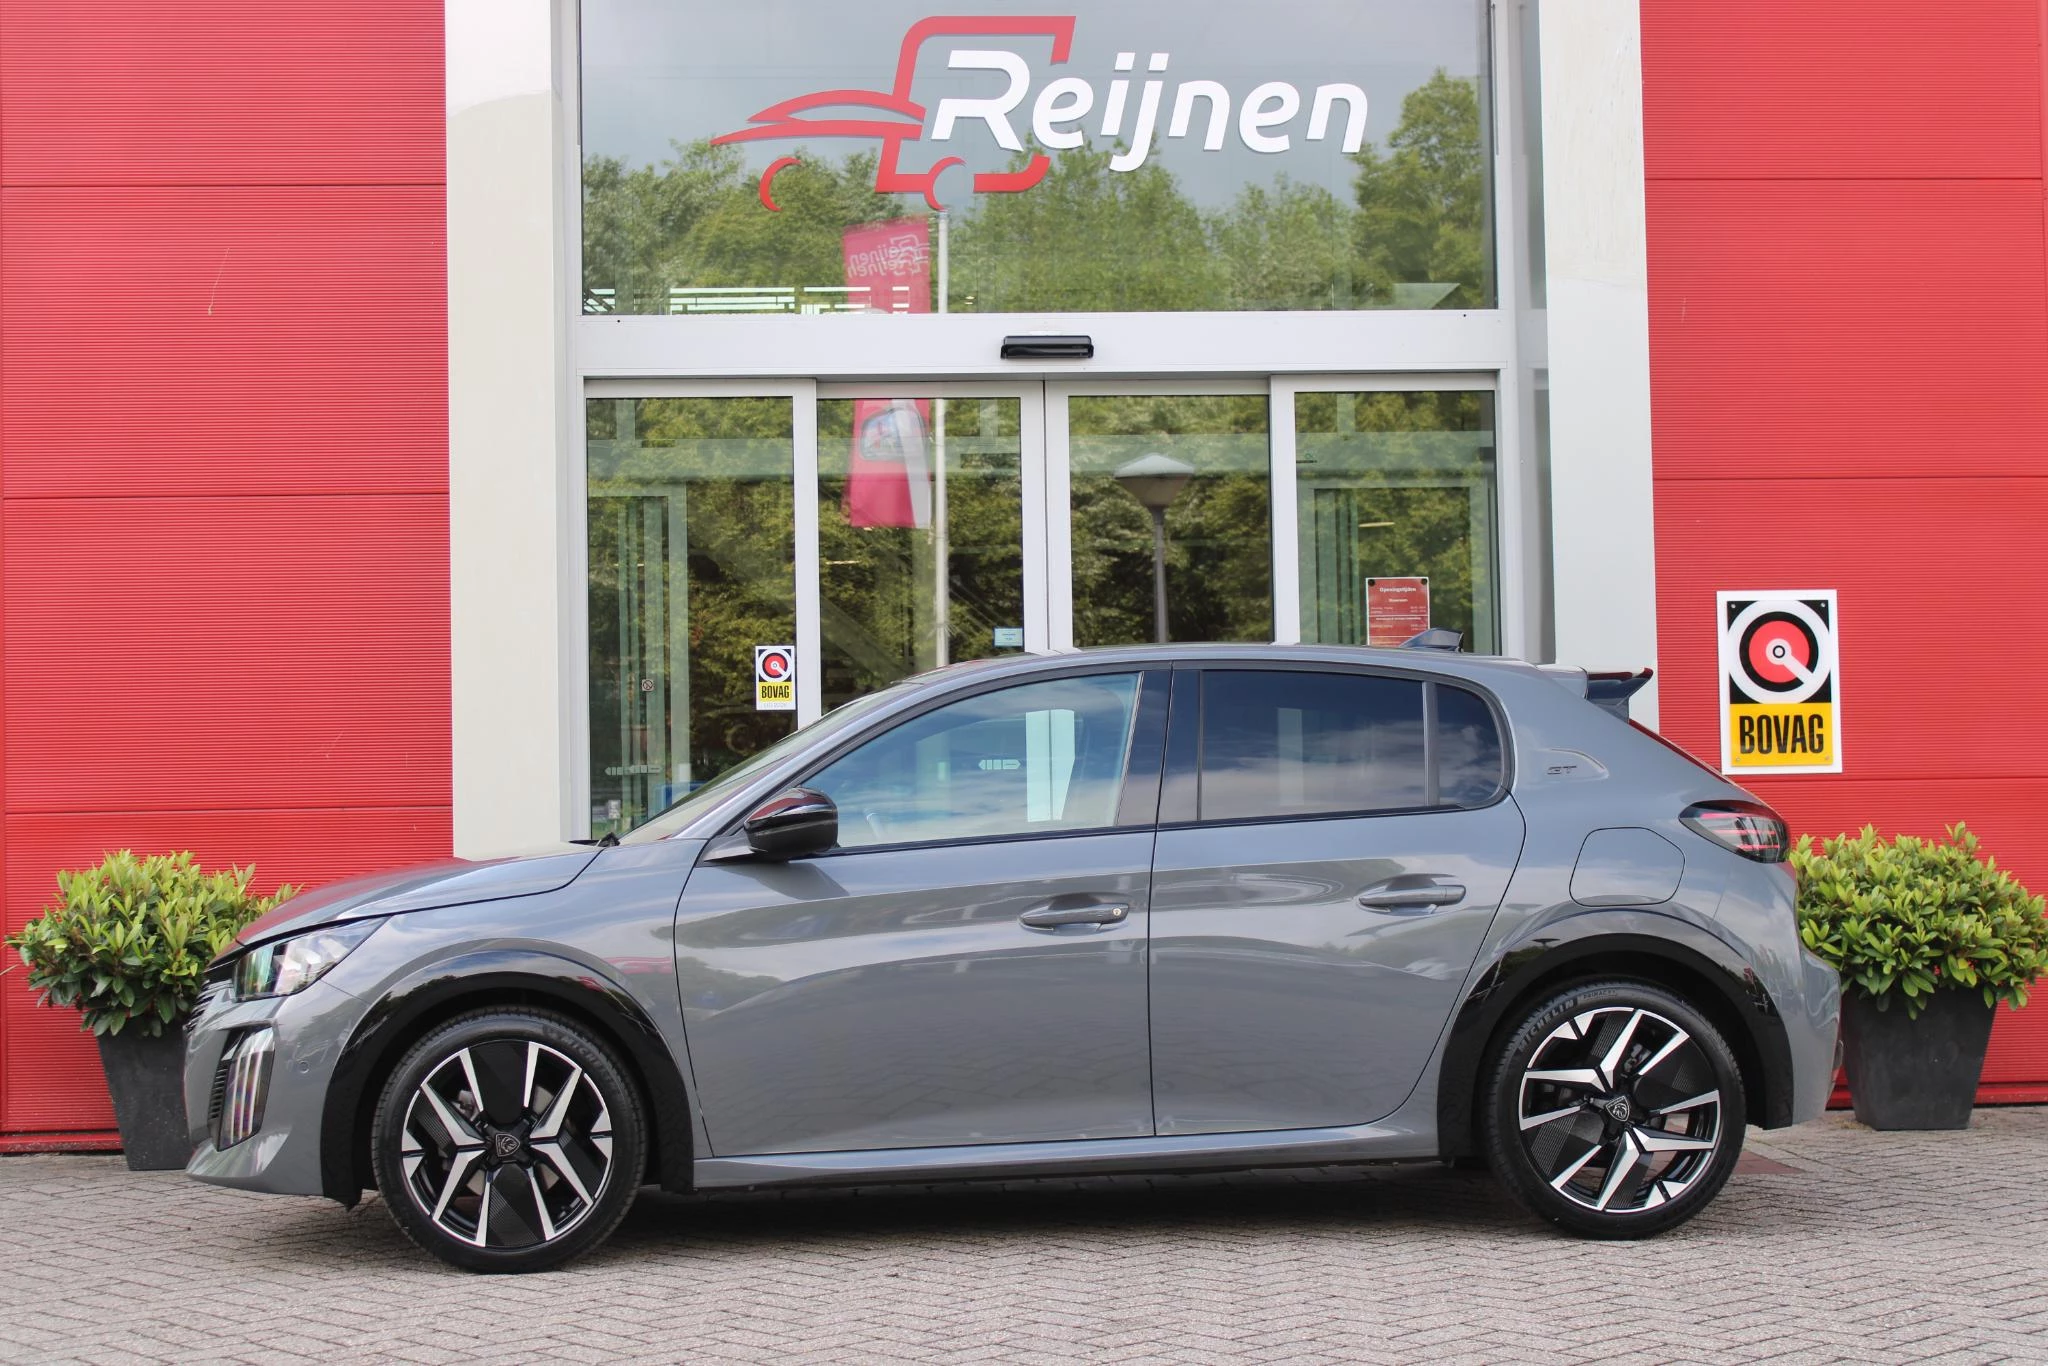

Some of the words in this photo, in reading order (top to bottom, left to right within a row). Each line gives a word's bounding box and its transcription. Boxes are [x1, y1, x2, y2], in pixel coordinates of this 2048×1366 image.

[931, 49, 1368, 172] Reijnen
[761, 685, 790, 699] BOVAG
[1738, 714, 1825, 755] BOVAG
[1518, 999, 1575, 1053] MICHELIN
